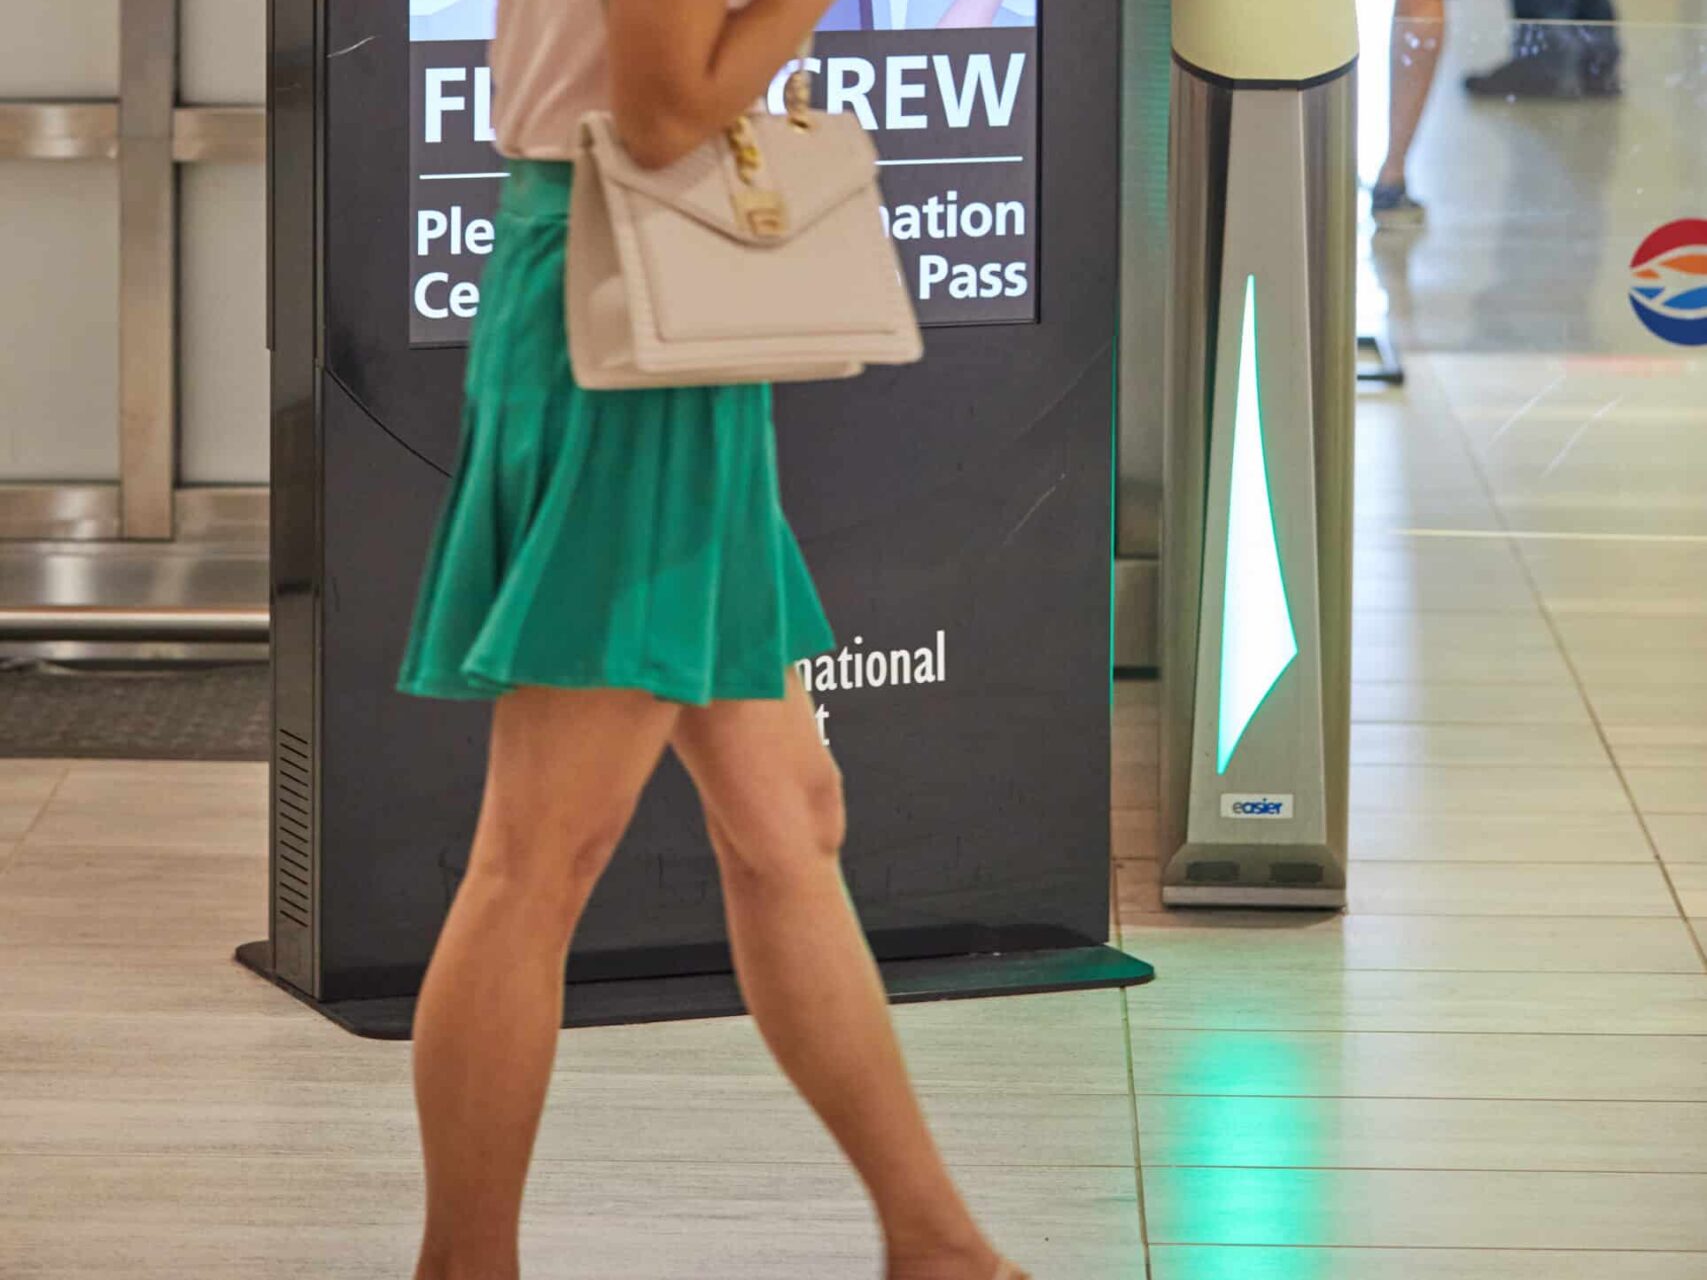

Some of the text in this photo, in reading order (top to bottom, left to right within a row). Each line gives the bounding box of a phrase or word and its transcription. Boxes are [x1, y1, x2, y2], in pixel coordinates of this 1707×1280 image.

[766, 52, 1026, 131] CREW
[417, 190, 1025, 256] Ple ation
[919, 254, 1028, 300] Pass
[794, 629, 946, 692] national
[1232, 797, 1283, 815] easier
